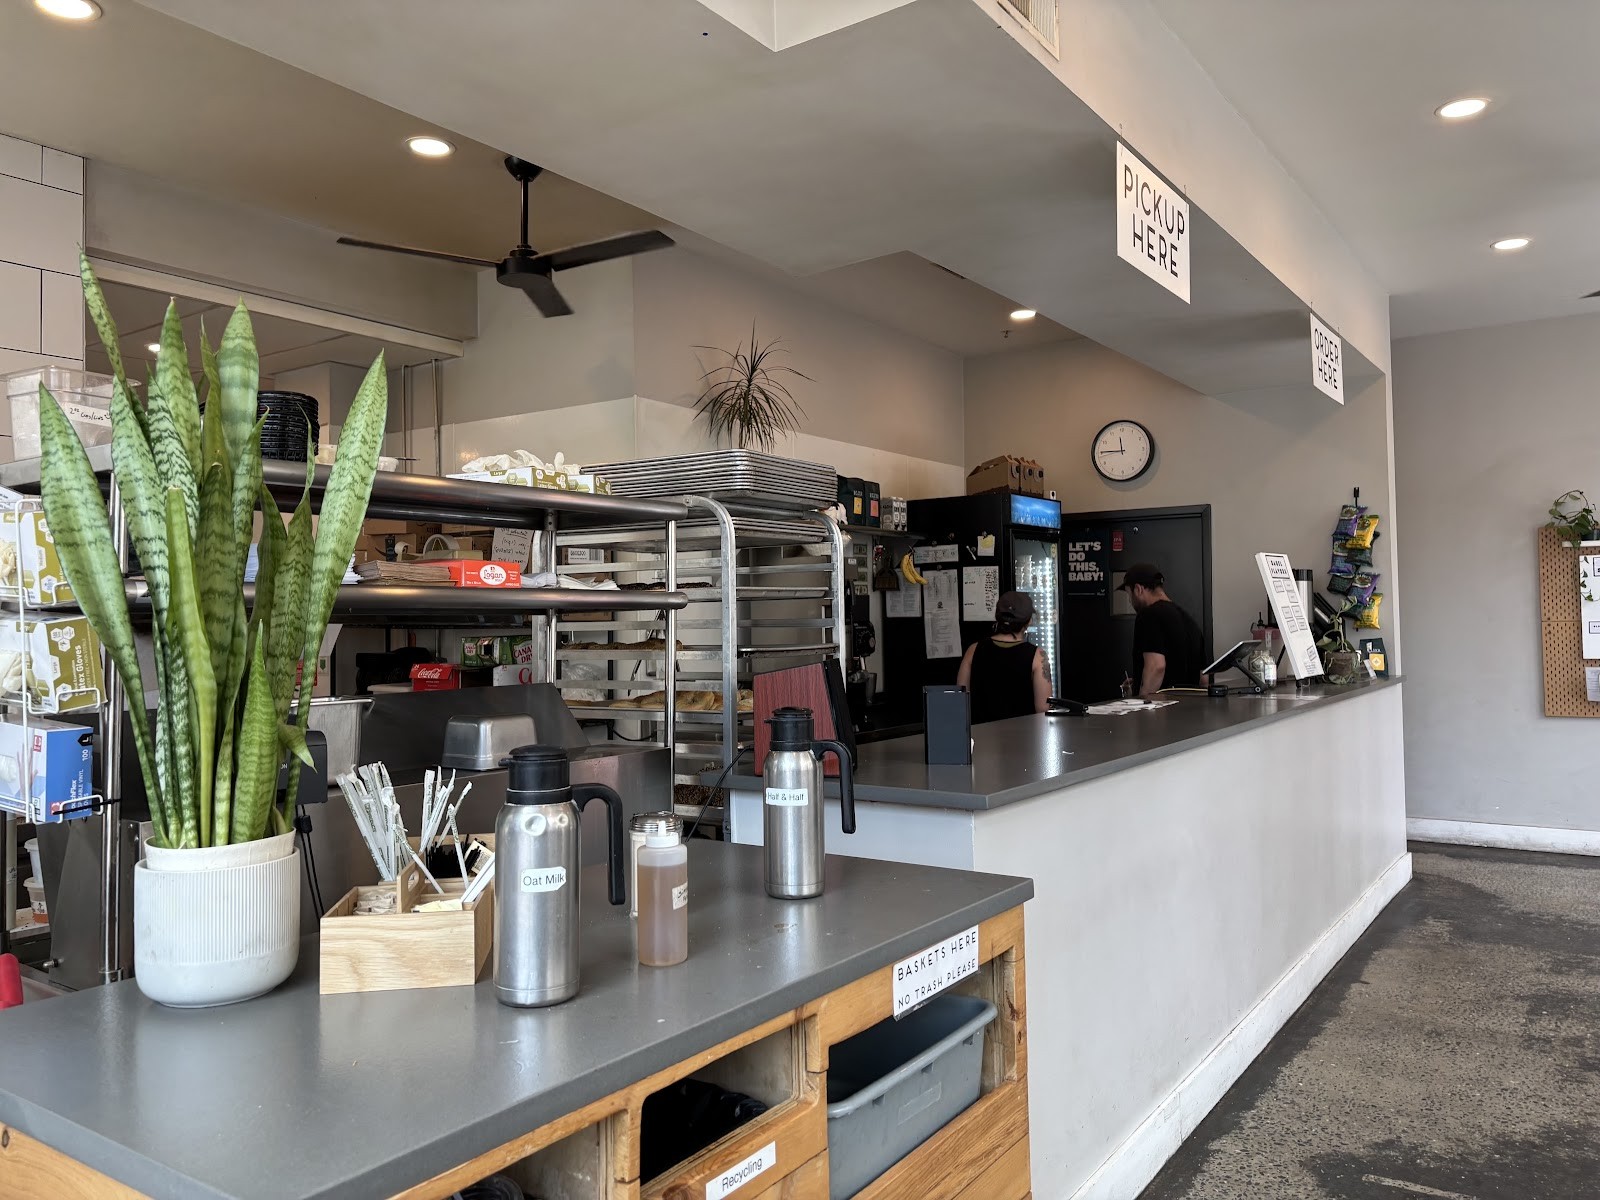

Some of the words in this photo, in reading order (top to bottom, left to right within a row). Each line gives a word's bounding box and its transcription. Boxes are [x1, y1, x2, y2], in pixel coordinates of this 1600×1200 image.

[1124, 163, 1185, 241] PICKUP
[1132, 213, 1179, 278] HERE
[1314, 328, 1339, 367] ORDER
[1317, 355, 1338, 390] HERE
[1068, 541, 1102, 552] LET'S
[1068, 552, 1086, 562] DO
[1068, 562, 1100, 573] THIS,
[1068, 572, 1104, 582] BABY!
[75, 644, 84, 672] Gloves
[513, 644, 532, 659] CANA
[767, 792, 780, 801] Half
[781, 793, 787, 801] &
[789, 793, 804, 801] Half
[523, 875, 542, 886] Oat
[545, 873, 565, 885] Milk
[897, 946, 946, 981] BASKETS
[951, 931, 977, 954] HERE
[898, 994, 911, 1009] NO
[915, 976, 943, 999] TRASH
[947, 958, 976, 983] PLEASE
[721, 1158, 763, 1192] Recycling
